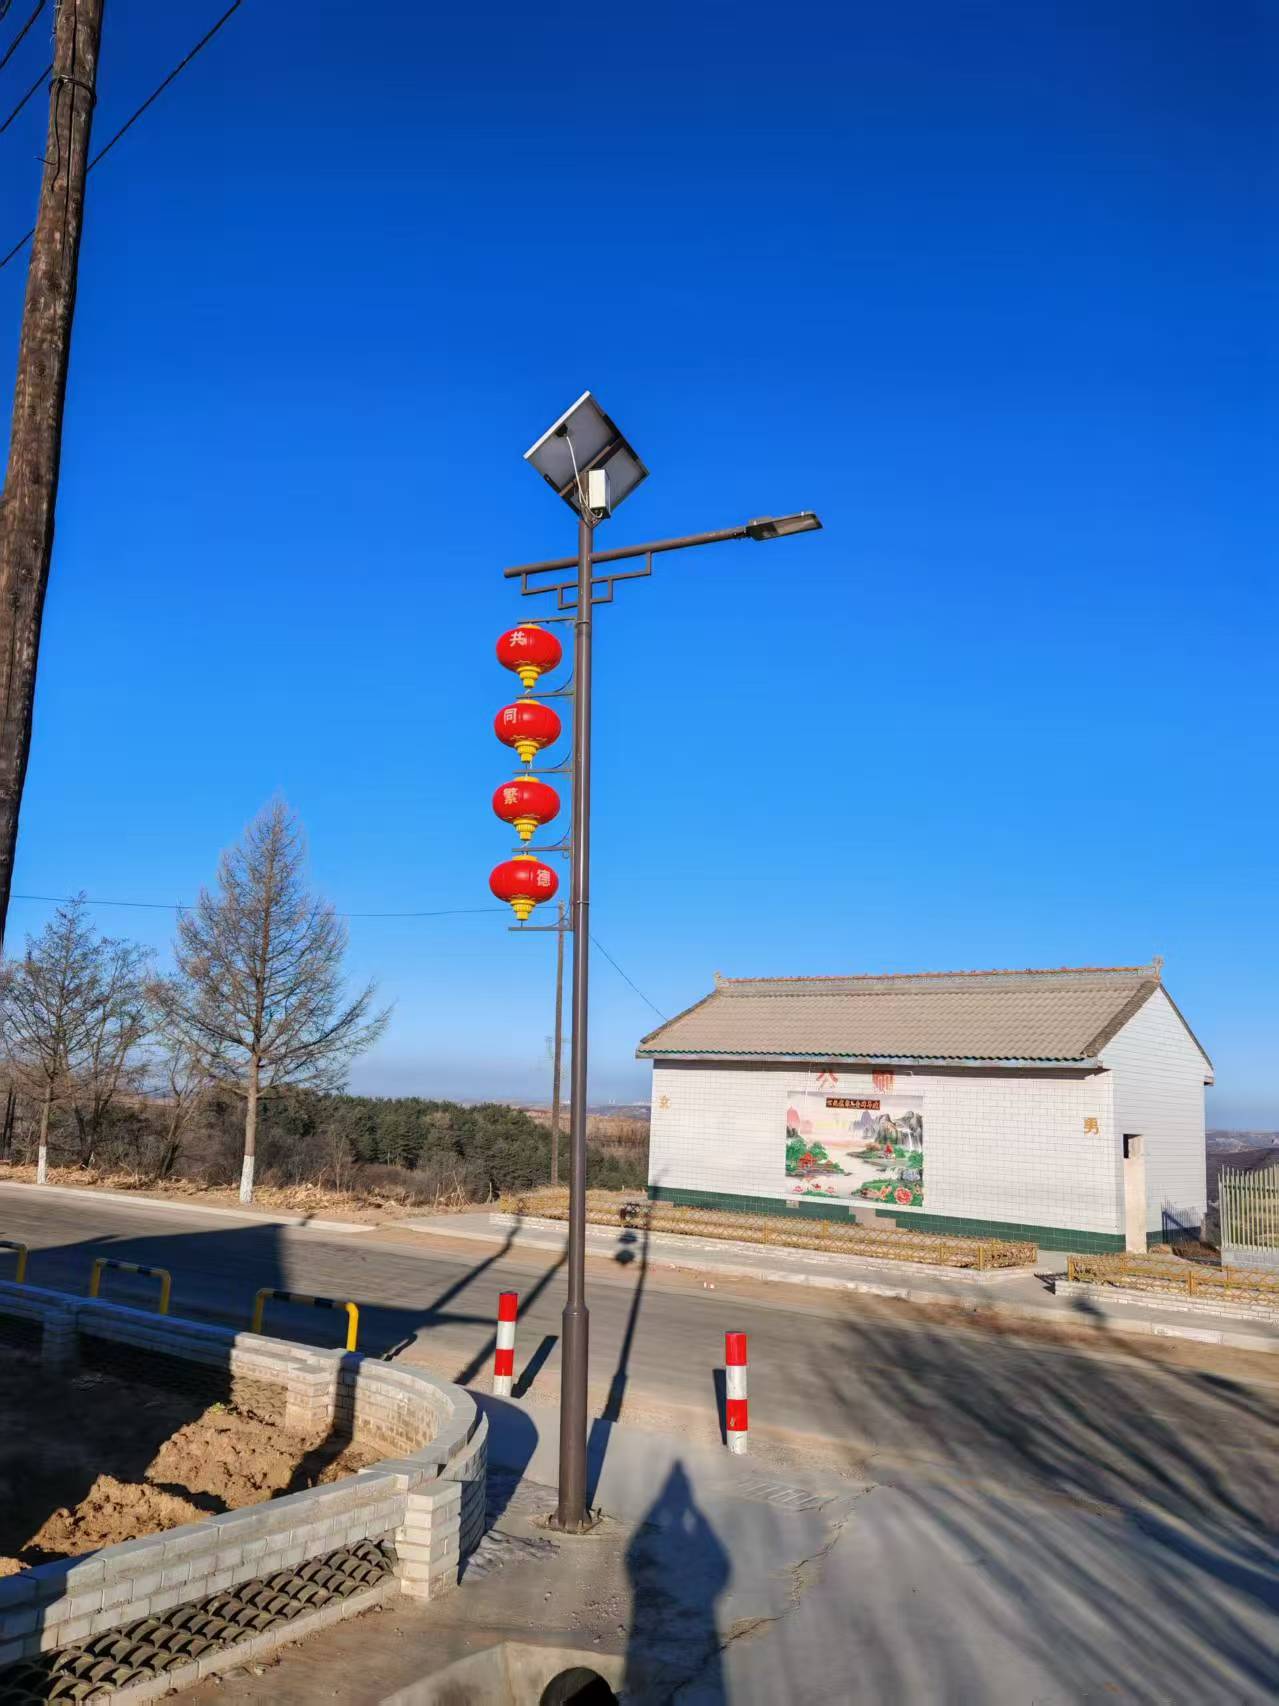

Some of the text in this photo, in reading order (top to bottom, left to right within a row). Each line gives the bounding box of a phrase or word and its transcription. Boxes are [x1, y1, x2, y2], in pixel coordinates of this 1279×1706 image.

[509, 631, 528, 647] 共
[503, 707, 518, 725] 同
[1083, 1116, 1099, 1136] 男
